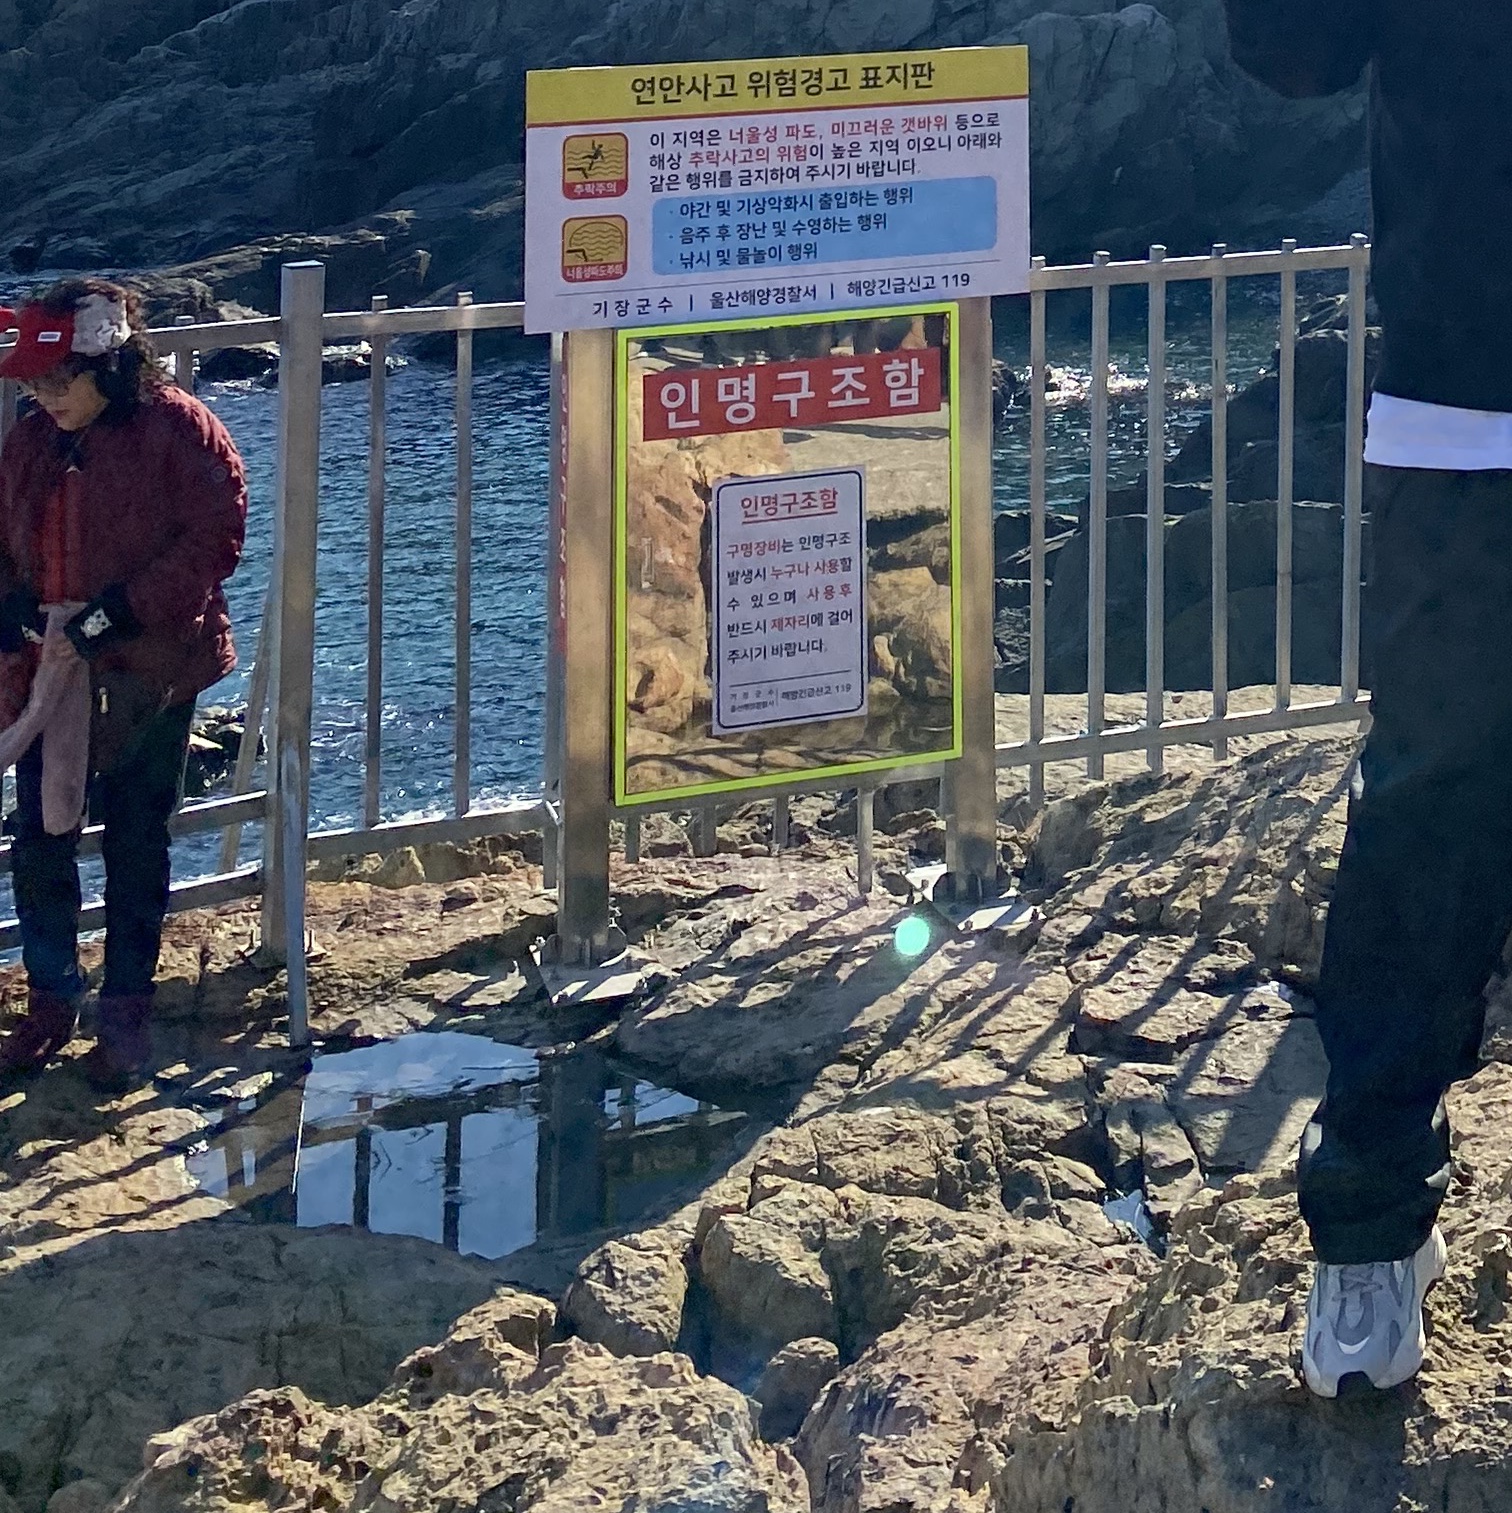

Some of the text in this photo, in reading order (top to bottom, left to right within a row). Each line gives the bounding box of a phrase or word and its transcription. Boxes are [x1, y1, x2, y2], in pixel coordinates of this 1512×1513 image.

[631, 61, 935, 106] 연안사고 위험경고 표지판
[650, 112, 1000, 149] 이 지역은 너울성 파도, 미끄러운 갯바위 등으로
[649, 132, 1002, 171] 해상 추락사고의 위험이 높은 지역 이오니 아래와
[649, 158, 921, 193] 같은 행위를 금지하여 주시기 바랍니다.
[679, 187, 914, 219] 야간 및 기상악화시 출입하는 행위
[679, 213, 888, 245] 음주 후 장난 및 수영하는 행위
[679, 241, 818, 269] 낚시 및 물놀이 행위
[710, 284, 817, 310] 울산해양경찰서
[846, 275, 938, 298] 해양긴급신고
[941, 272, 970, 289] 119
[740, 487, 838, 519] 인명구조함
[726, 531, 852, 559] 구명장비는 인명구조
[727, 556, 853, 586] 발생시 누구나 사용할
[727, 597, 741, 612] 수
[750, 589, 797, 609] 있으며
[727, 619, 767, 639] 반드시
[828, 608, 853, 626] 걸어
[727, 645, 767, 665] 주시기
